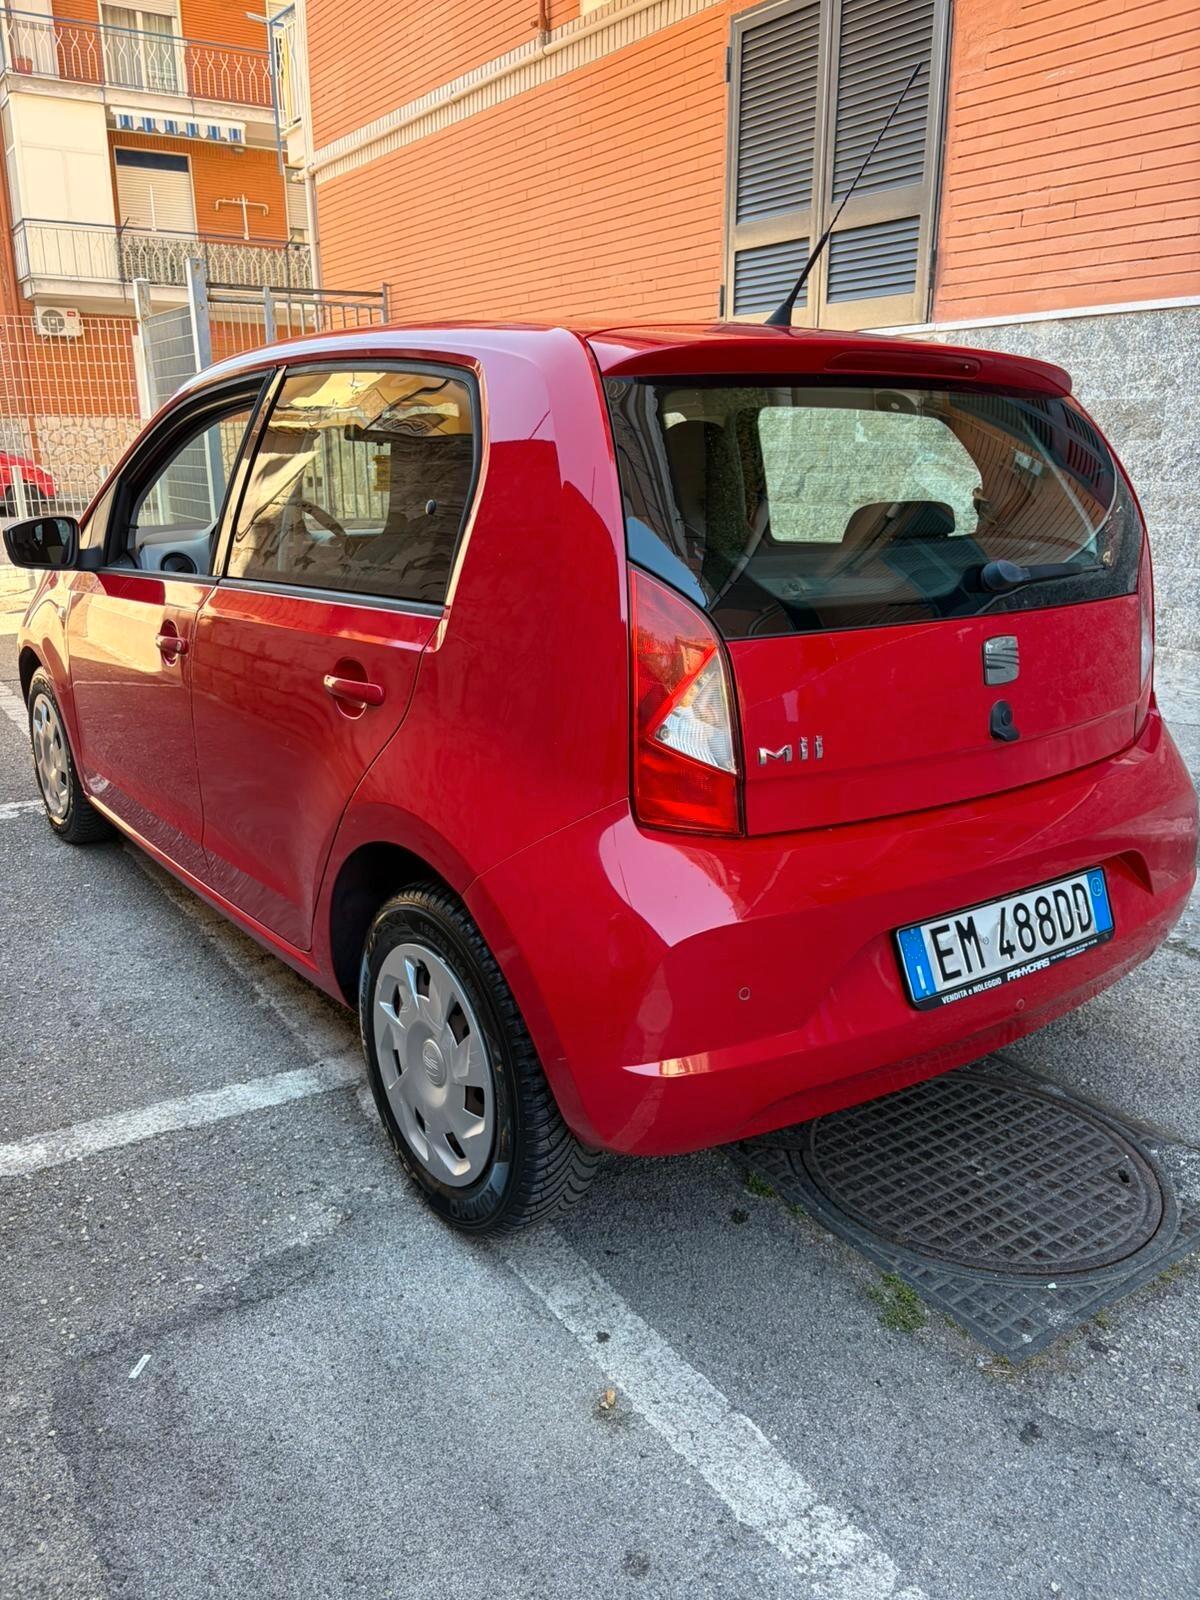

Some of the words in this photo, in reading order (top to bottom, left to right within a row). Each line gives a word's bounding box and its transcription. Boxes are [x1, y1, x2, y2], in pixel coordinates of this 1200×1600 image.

[758, 735, 823, 765] Mii
[929, 915, 986, 982] EM
[998, 882, 1093, 961] 488DD
[916, 965, 927, 990] I
[941, 990, 968, 1004] VENDITA
[973, 977, 1002, 994] NOLEGGIO
